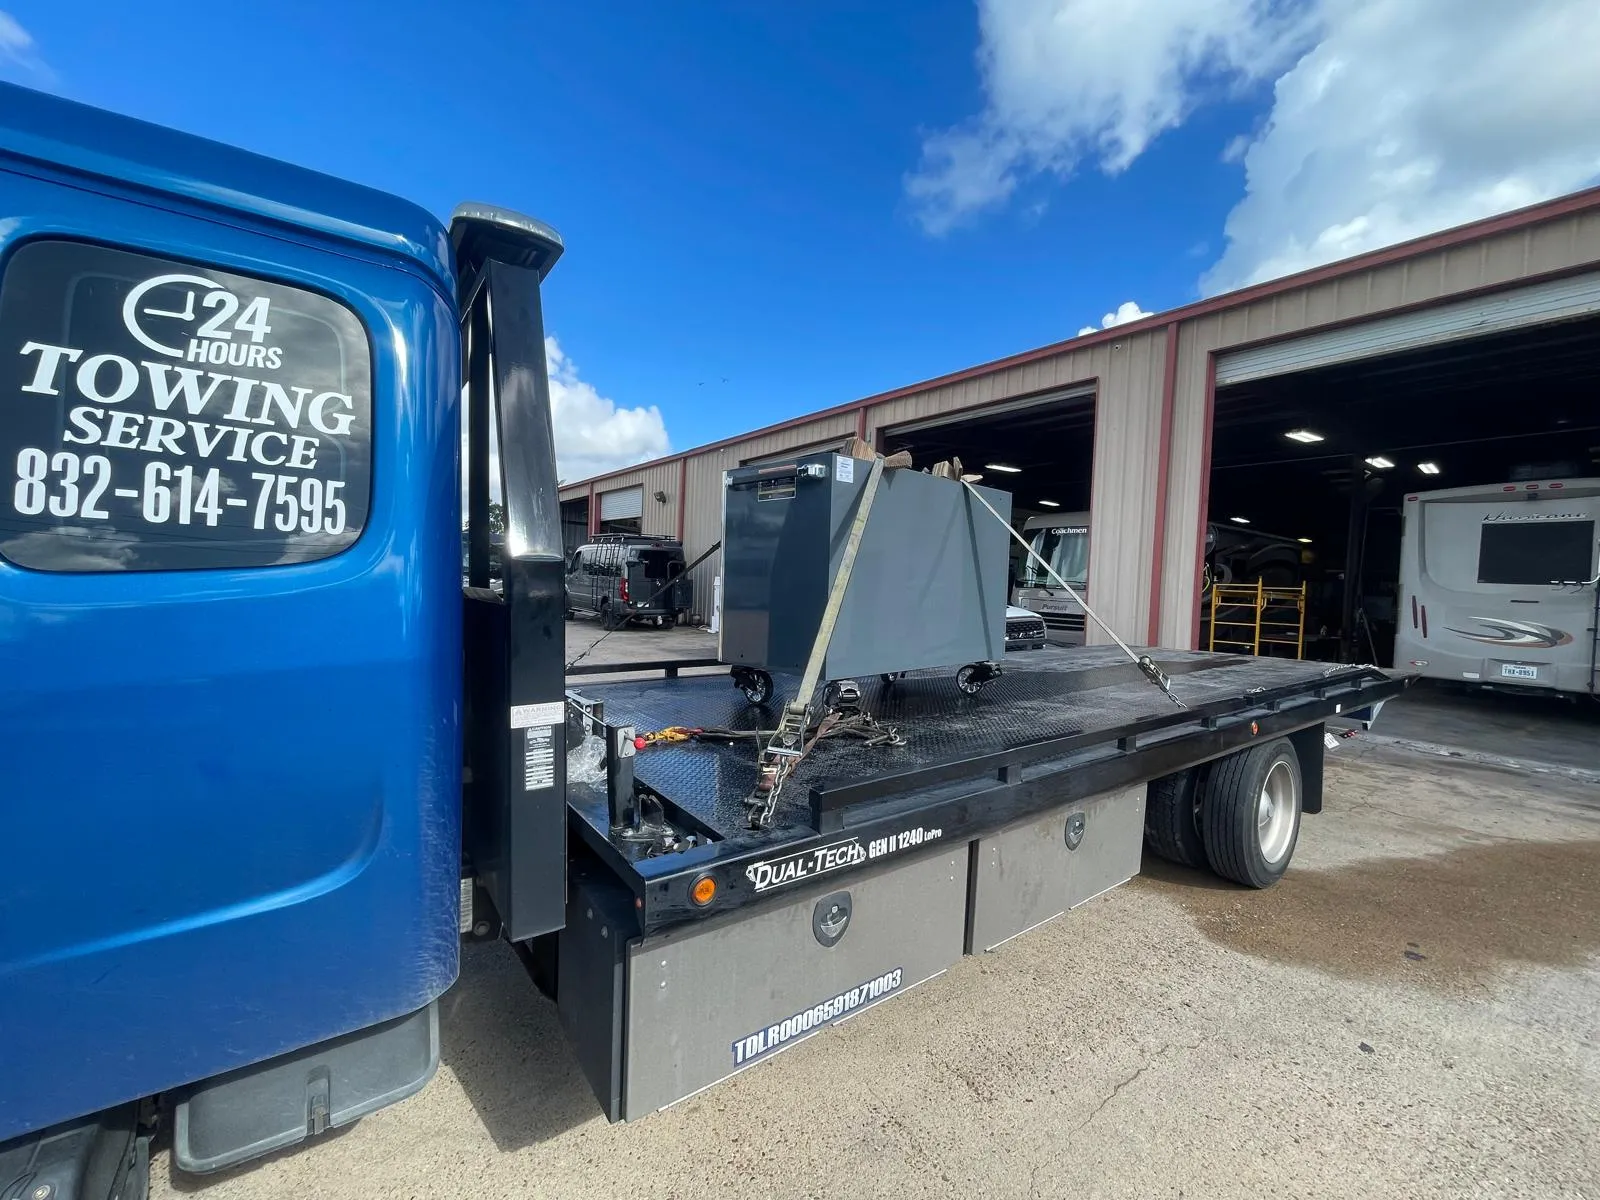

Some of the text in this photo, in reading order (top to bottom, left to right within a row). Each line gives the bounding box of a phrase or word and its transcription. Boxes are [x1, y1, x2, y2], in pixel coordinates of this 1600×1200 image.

[197, 291, 271, 342] 24
[187, 339, 283, 369] HOURS
[20, 342, 355, 435] TOWING
[64, 407, 319, 469] SERVICE
[15, 448, 345, 534] 832-614-7595
[1051, 527, 1087, 535] Coachmen
[868, 840, 888, 859] GEN
[889, 834, 897, 853] II
[898, 827, 924, 849] 1240
[924, 828, 942, 841] LoPro
[734, 968, 902, 1064] TDLR0006591871003
